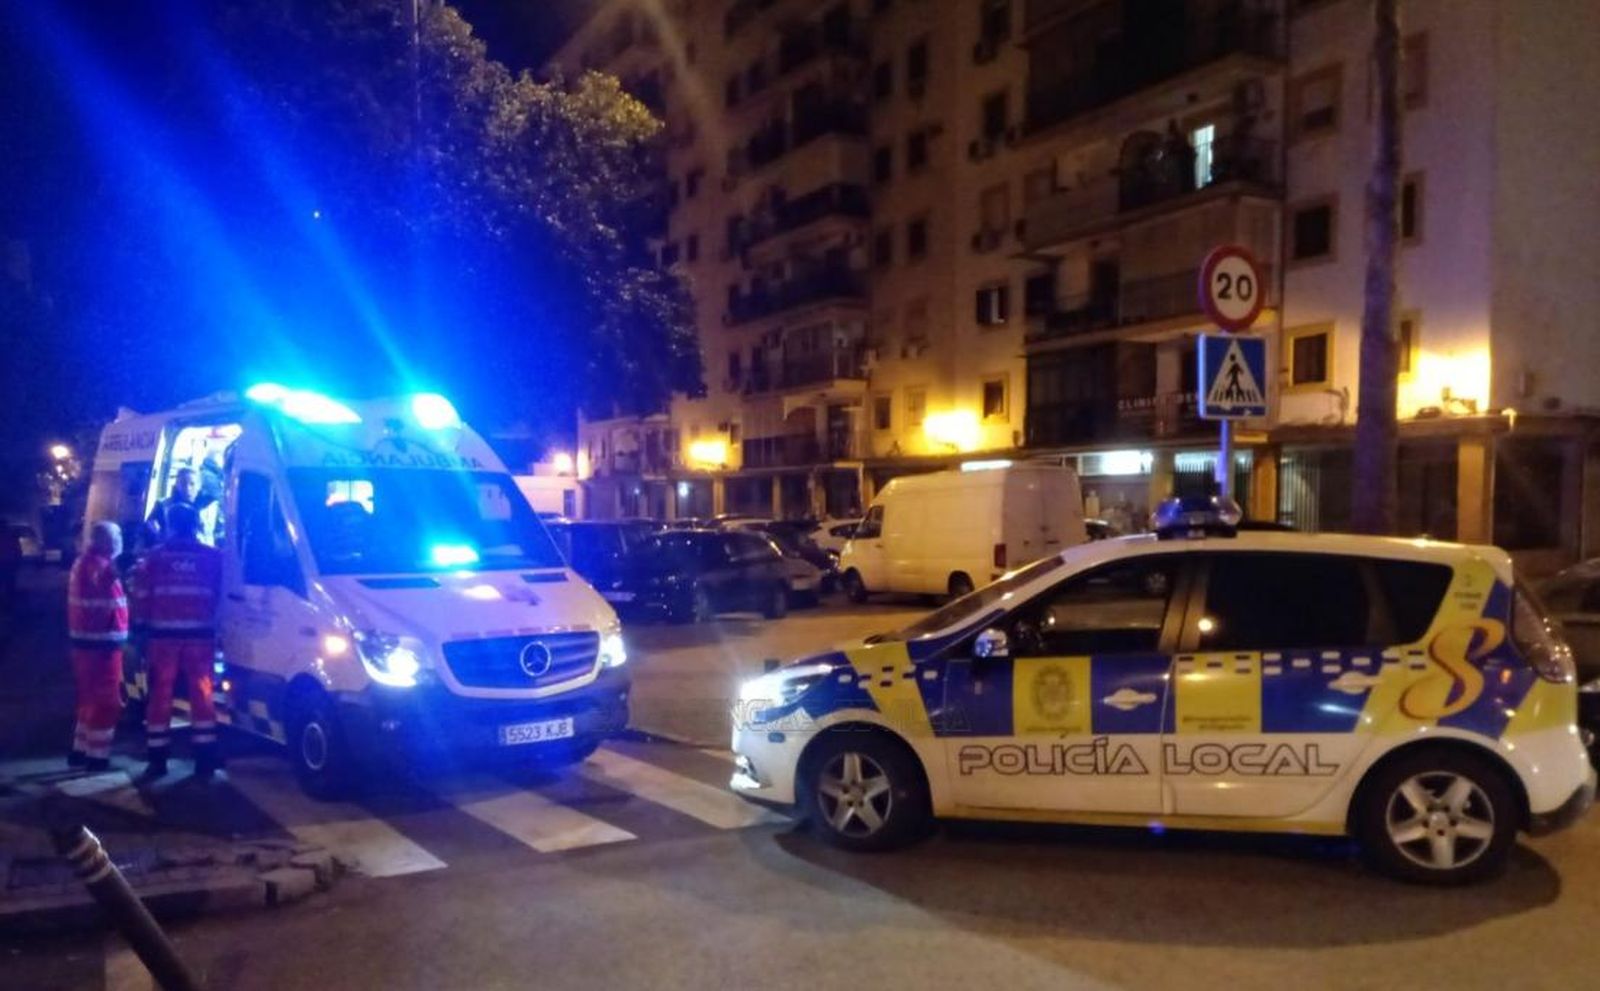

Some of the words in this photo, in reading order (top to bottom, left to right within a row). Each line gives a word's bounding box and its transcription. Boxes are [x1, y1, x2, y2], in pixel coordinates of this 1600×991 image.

[1216, 272, 1253, 302] 20
[508, 724, 542, 742] 5523
[958, 735, 1149, 776] POLICÍA
[1163, 742, 1341, 776] LOCAL
